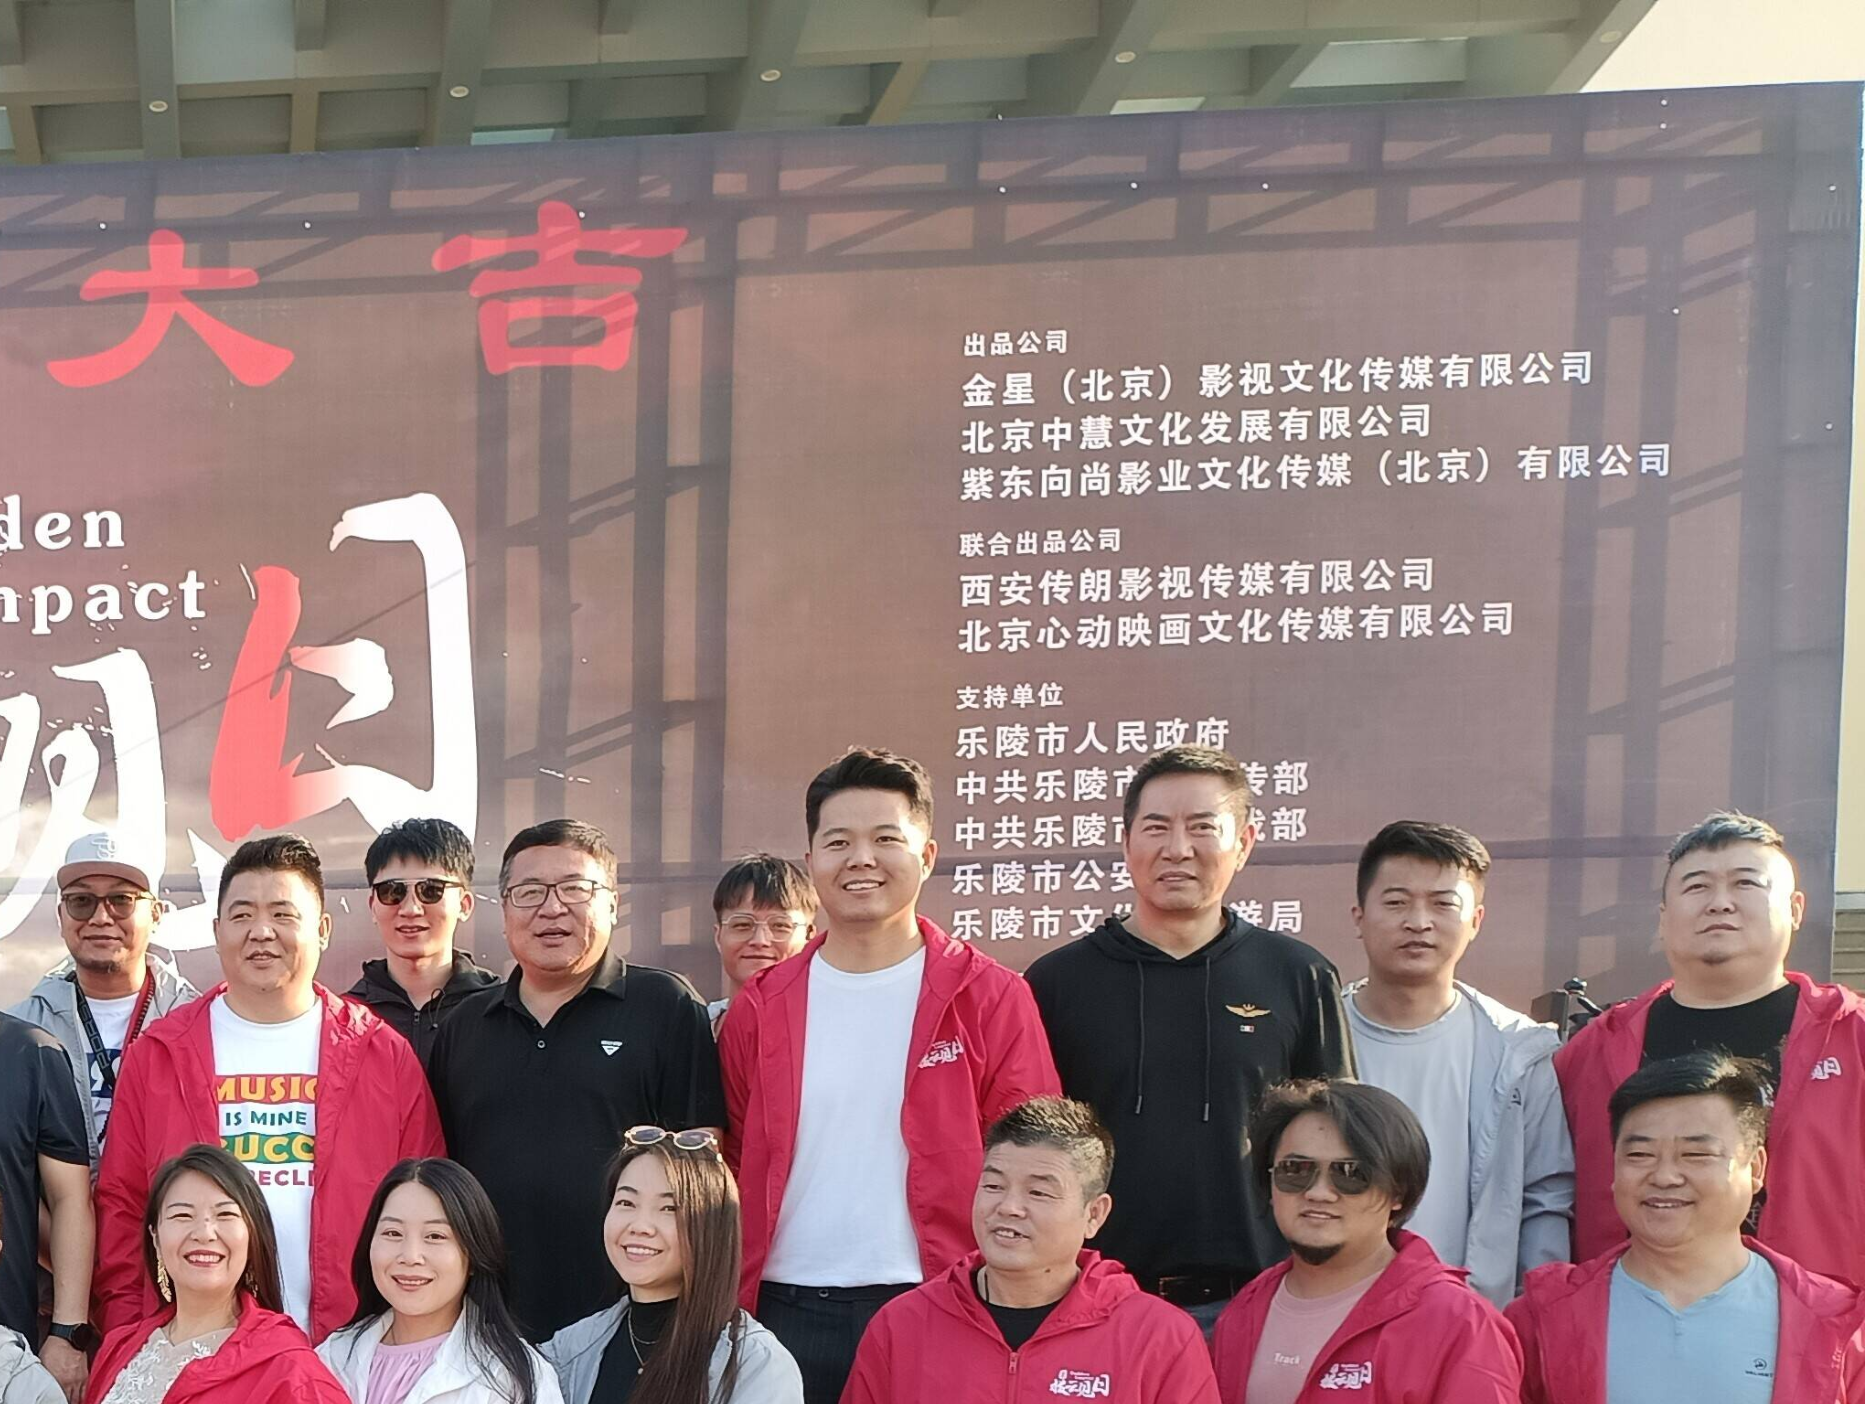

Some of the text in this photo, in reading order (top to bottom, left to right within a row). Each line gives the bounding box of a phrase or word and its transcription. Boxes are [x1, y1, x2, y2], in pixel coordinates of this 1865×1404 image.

[964, 330, 1068, 357] 出品公司
[961, 403, 1431, 454] 北京中慧文化发展有限公司
[959, 528, 1121, 557] 联合出品公司
[959, 557, 1433, 607] 西安传朗影视传媒有限公司
[957, 602, 1513, 653] 北京心动映画文化传媒有限公司
[956, 682, 1064, 710] 支持单位
[955, 717, 1229, 759] 乐陵市人民政府
[955, 761, 1309, 805] 中共乐陵市传部
[225, 1110, 307, 1126] IS MINE
[220, 1134, 314, 1163] UCC
